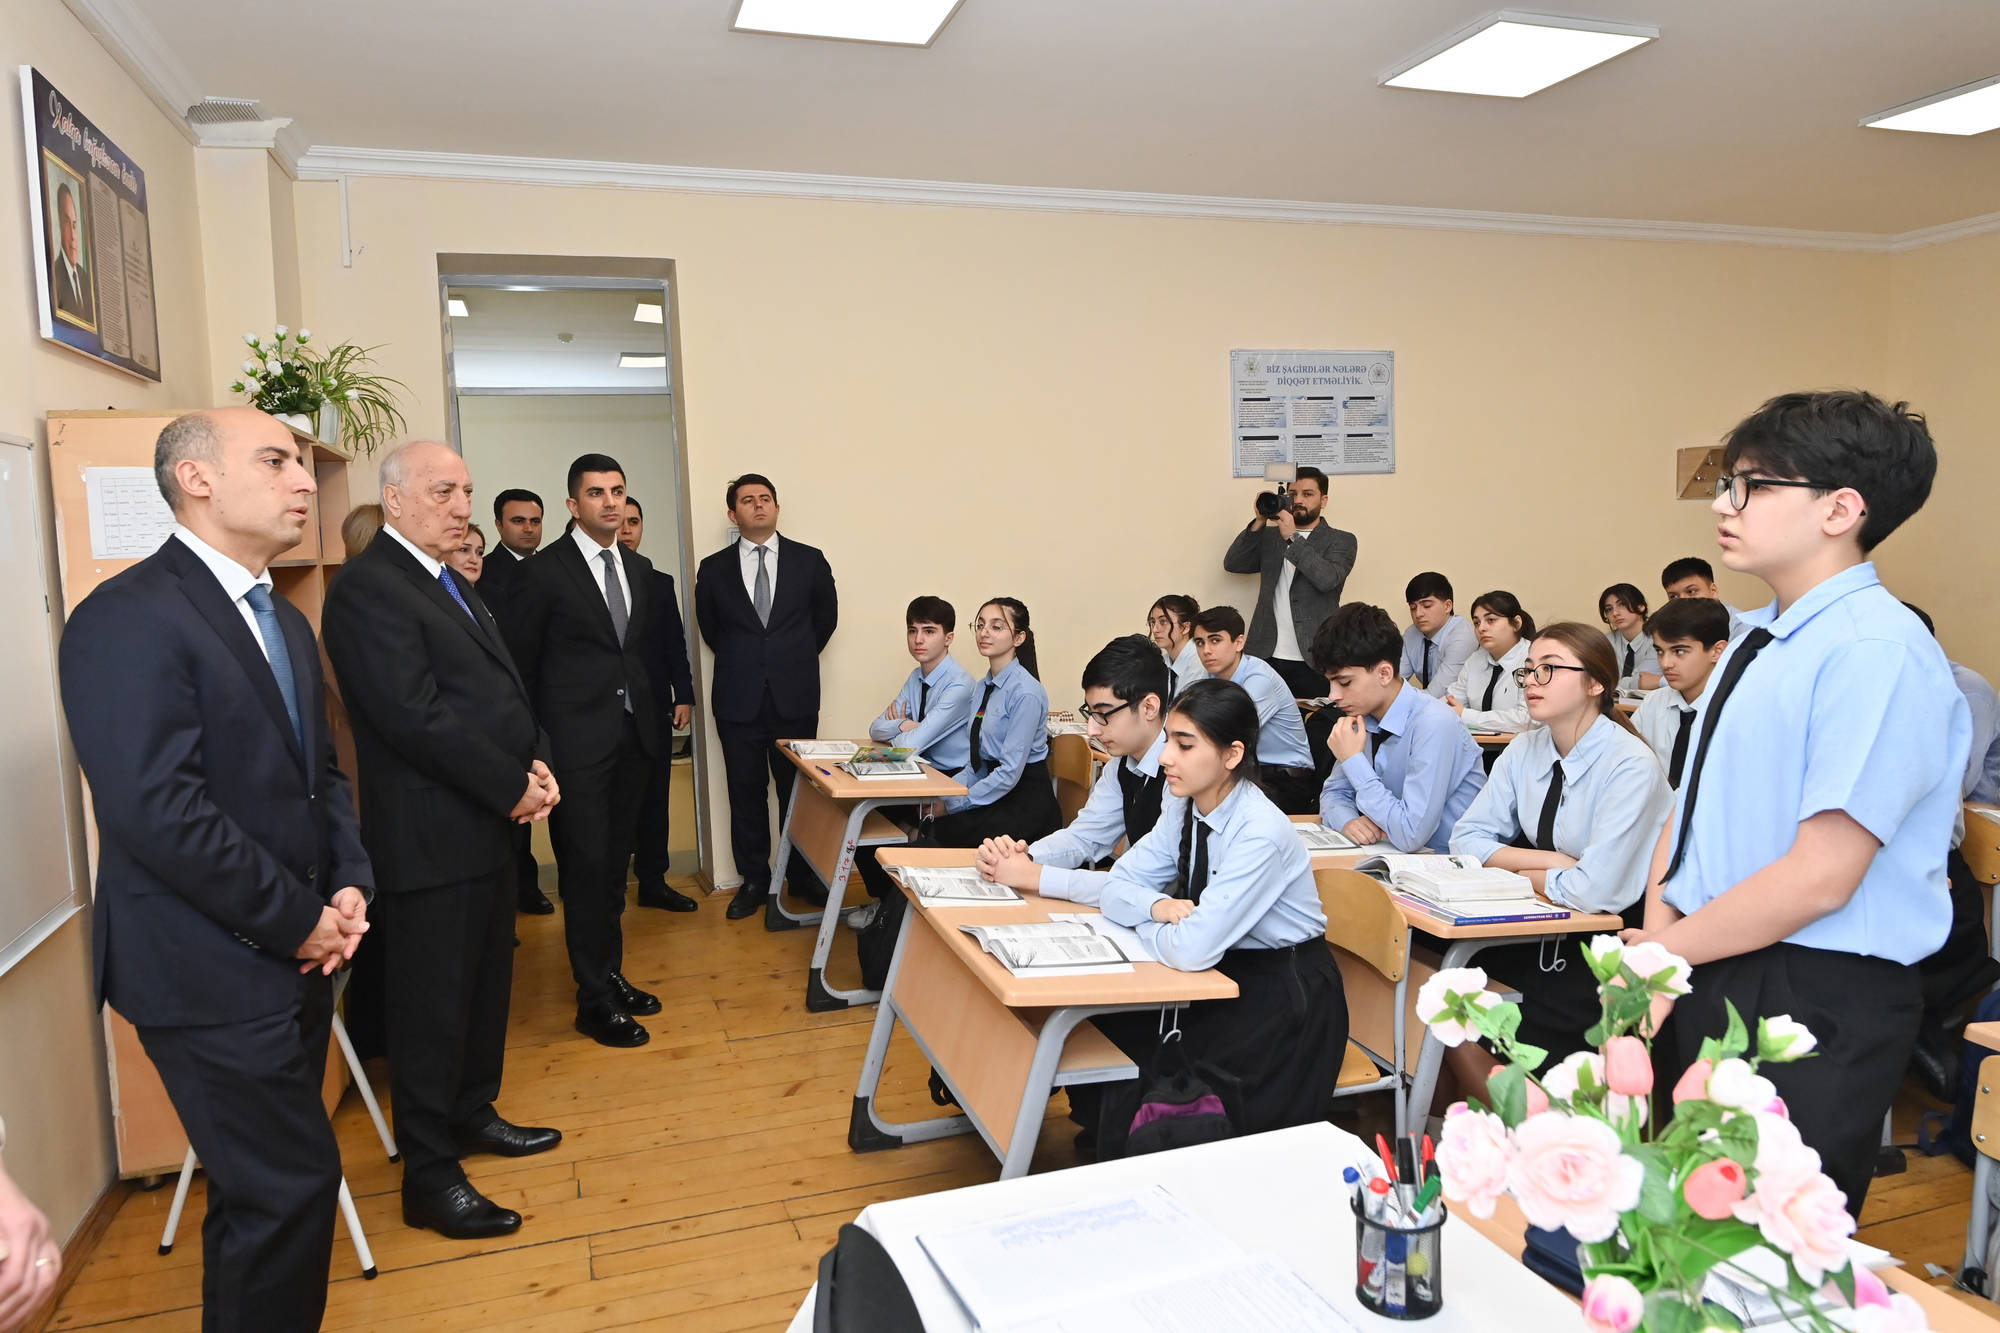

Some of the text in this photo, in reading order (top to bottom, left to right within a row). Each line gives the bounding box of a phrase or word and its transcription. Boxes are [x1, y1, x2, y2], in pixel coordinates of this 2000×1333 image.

[1266, 363, 1367, 375] BİZ ŞAGİRDLƏR NƏLƏRƏ
[1277, 376, 1311, 386] DİQQƏT
[1312, 376, 1363, 385] ETMƏLİYİK.
